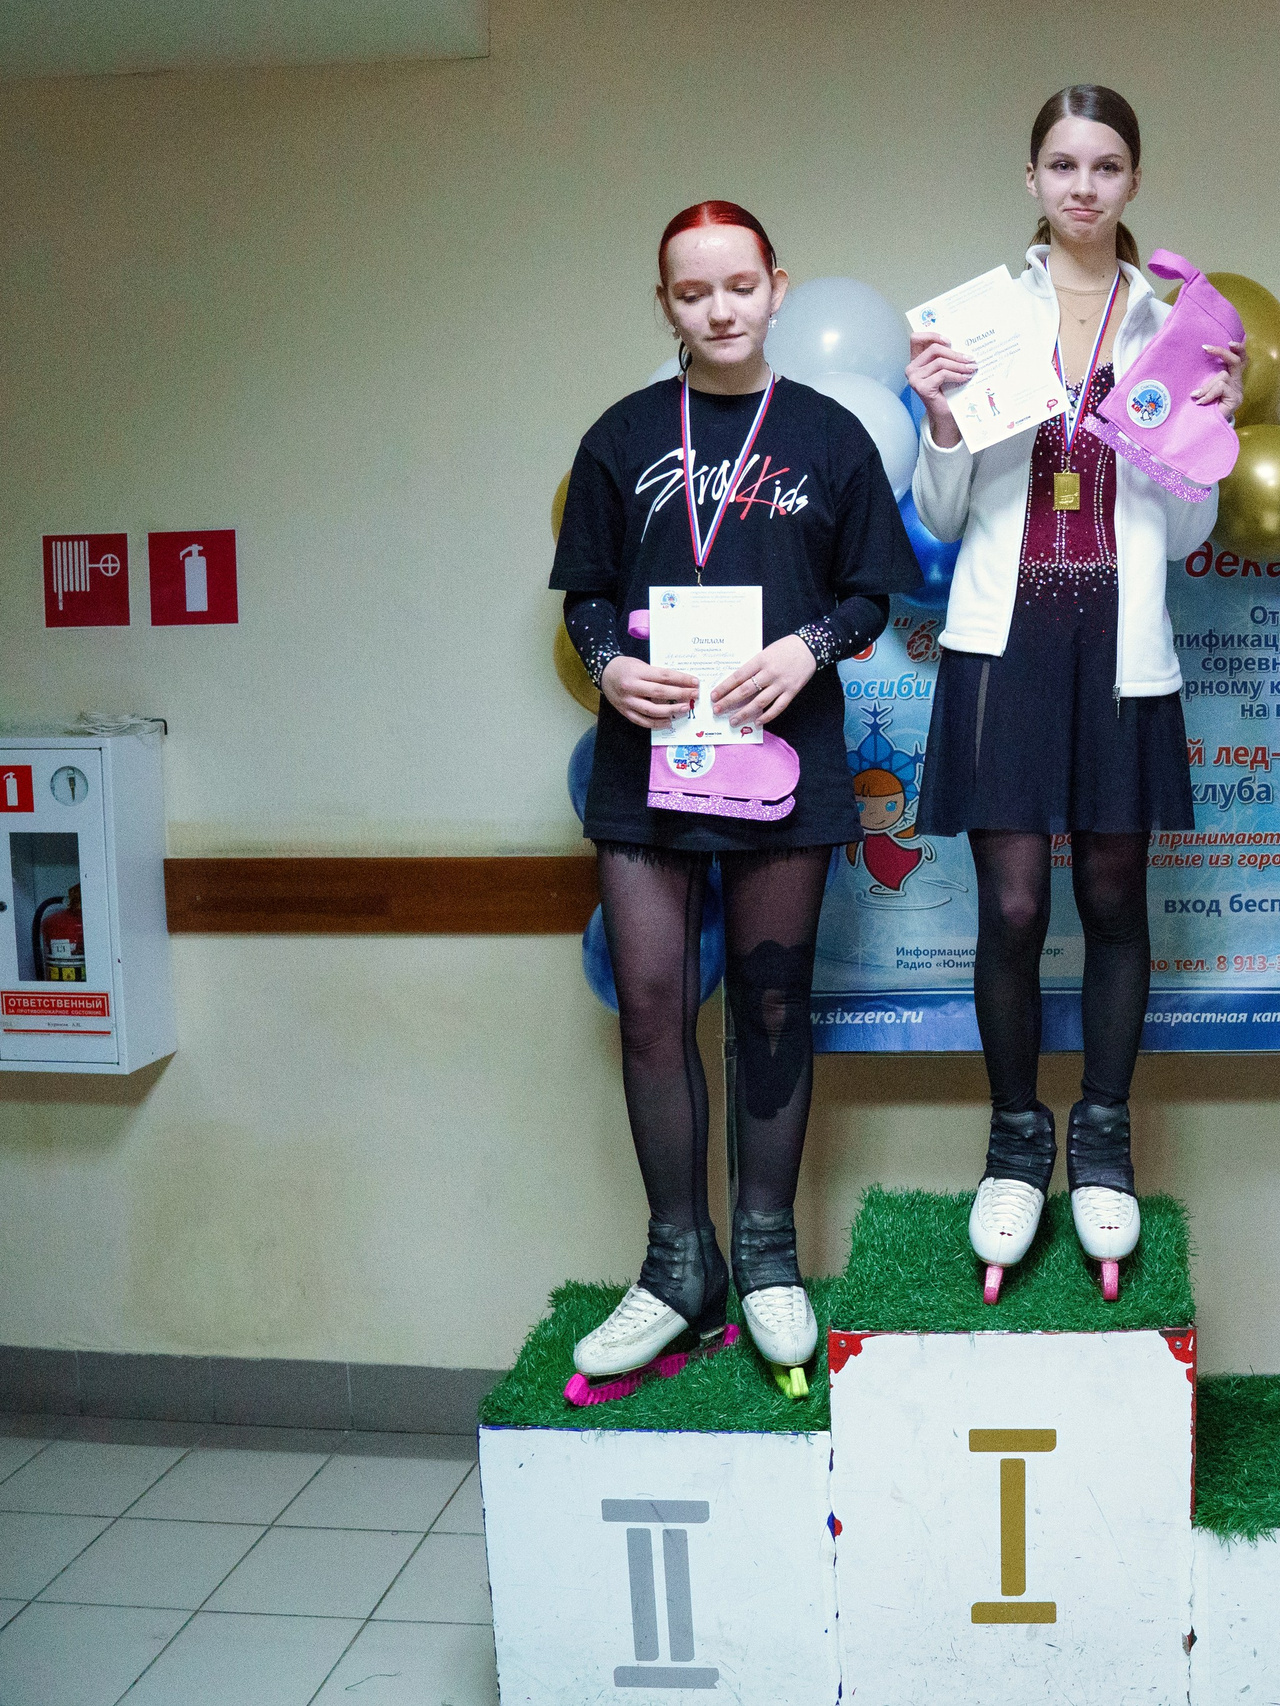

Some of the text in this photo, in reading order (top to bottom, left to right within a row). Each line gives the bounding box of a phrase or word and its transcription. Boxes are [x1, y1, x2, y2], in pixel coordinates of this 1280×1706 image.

[736, 455, 809, 520] Kids
[691, 637, 725, 645] Диплом
[841, 671, 933, 699] осиби
[1241, 703, 1269, 717] на
[1158, 832, 1280, 849] принимают
[1208, 854, 1231, 866] из
[1164, 899, 1222, 917] вход
[896, 959, 932, 970] Радио
[1173, 959, 1210, 971] тел.
[1216, 955, 1227, 970] 8
[8, 998, 103, 1009] ОТВЕТСТВЕННЫЙ
[1144, 1012, 1247, 1026] возрастная
[601, 1499, 719, 1690] II
